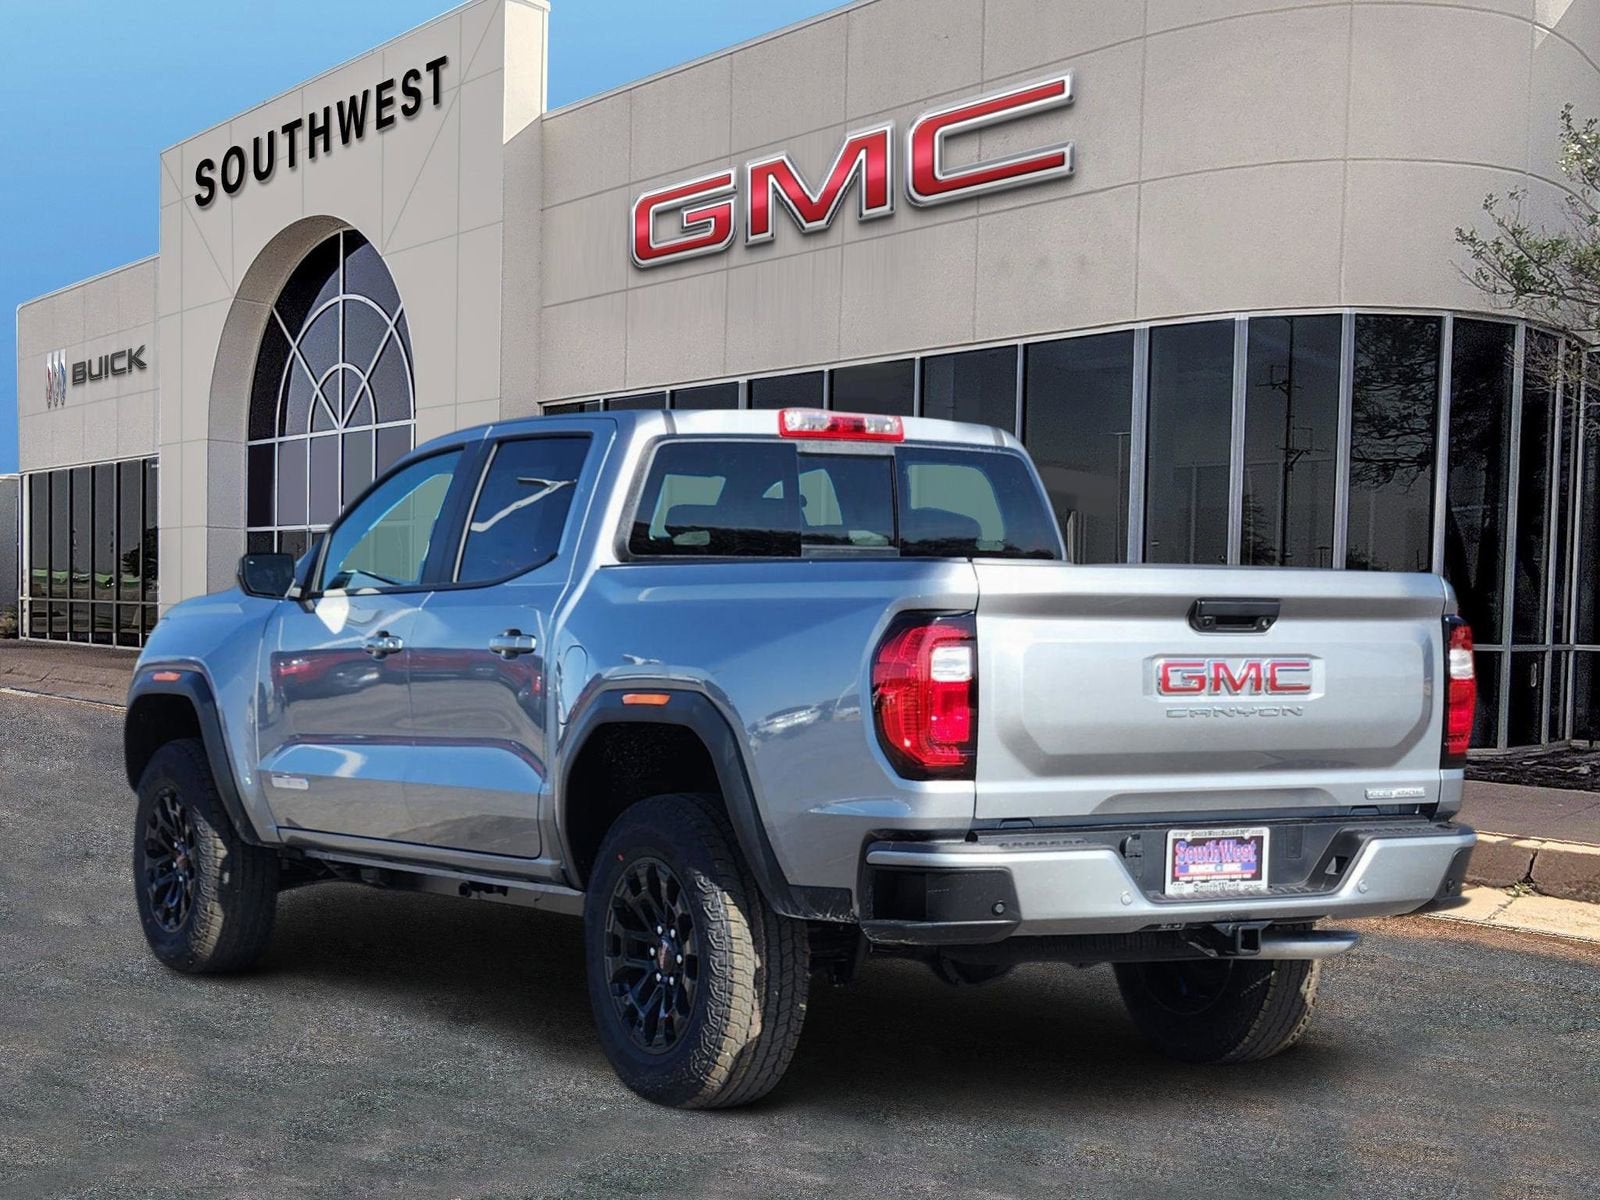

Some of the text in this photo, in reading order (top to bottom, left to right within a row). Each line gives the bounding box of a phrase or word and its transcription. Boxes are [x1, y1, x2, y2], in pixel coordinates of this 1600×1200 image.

[194, 55, 448, 207] SOUTHWEST
[630, 70, 1075, 269] GMC
[72, 344, 147, 385] BUICK
[1157, 659, 1312, 696] GMC
[1166, 705, 1303, 718] CANYON
[1175, 840, 1257, 864] SouthWest
